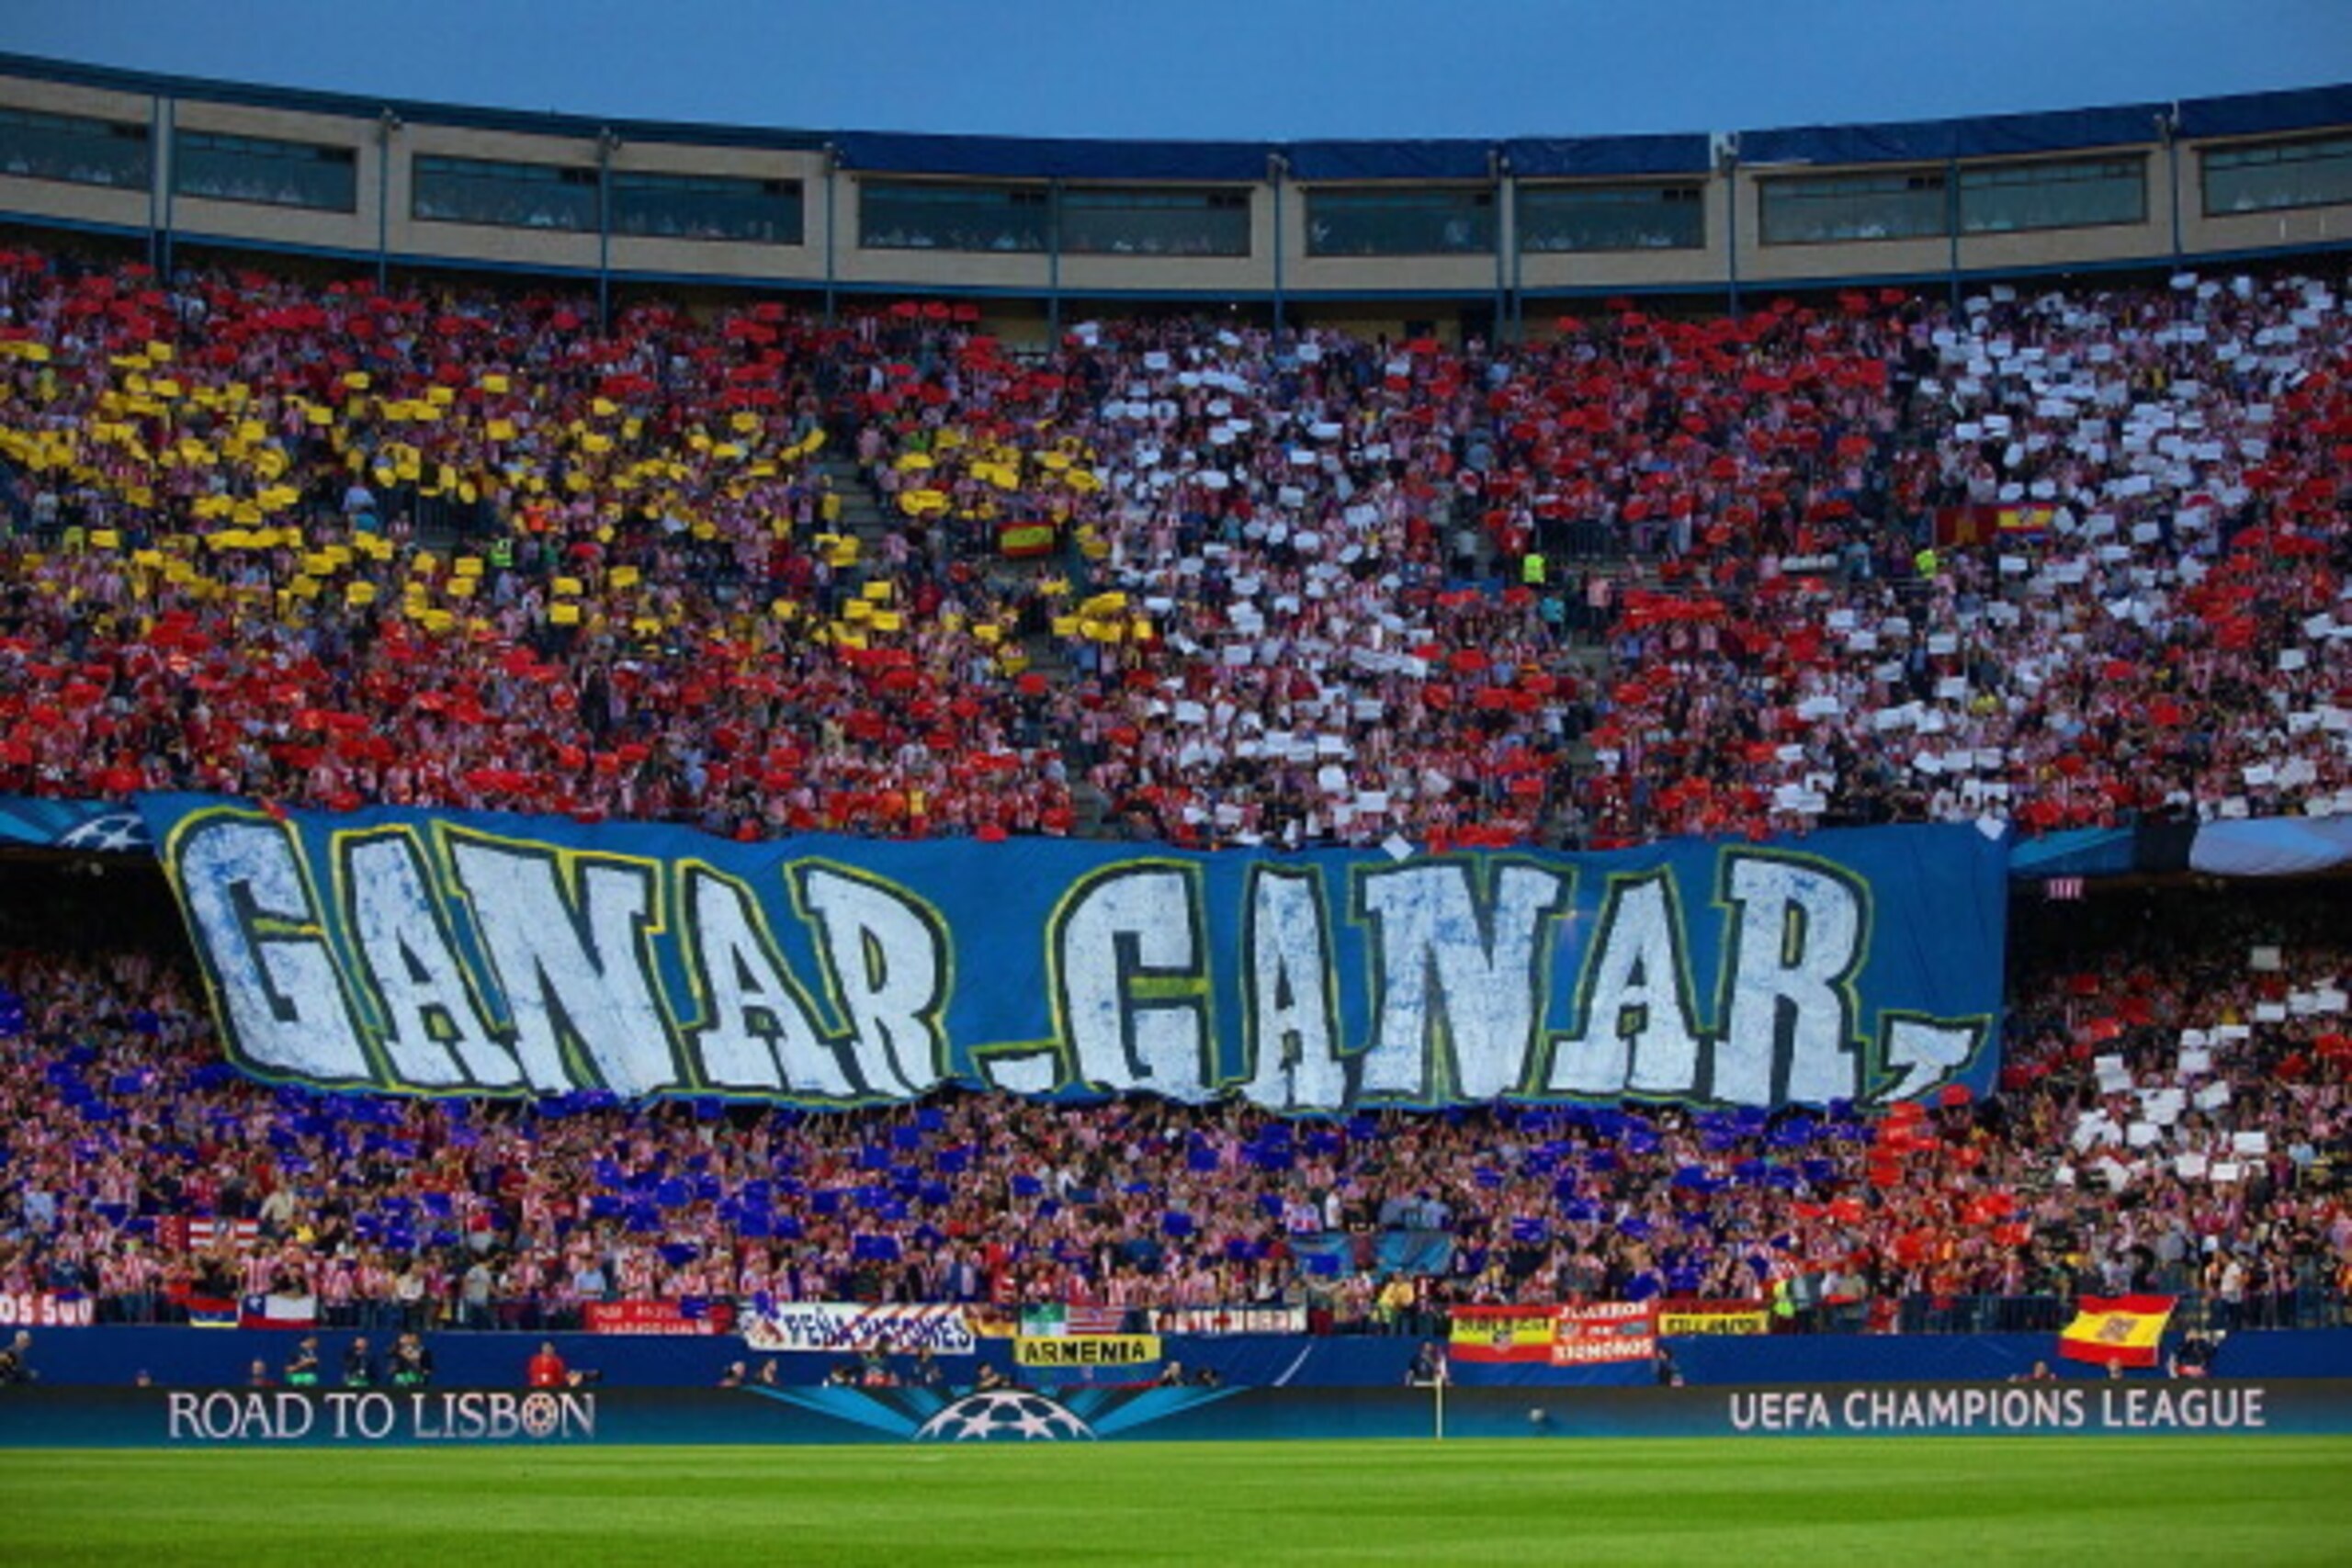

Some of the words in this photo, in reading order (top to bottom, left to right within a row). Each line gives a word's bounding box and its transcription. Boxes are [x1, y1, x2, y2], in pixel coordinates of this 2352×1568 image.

[1023, 1339, 1146, 1363] ARMENIA
[168, 1391, 314, 1438] ROAD
[324, 1391, 395, 1438] TO
[413, 1391, 596, 1438] LISBON
[1730, 1393, 1831, 1430] UEFA
[1843, 1389, 2086, 1429] CHAMPIONS
[2101, 1388, 2266, 1427] LEAGUE
